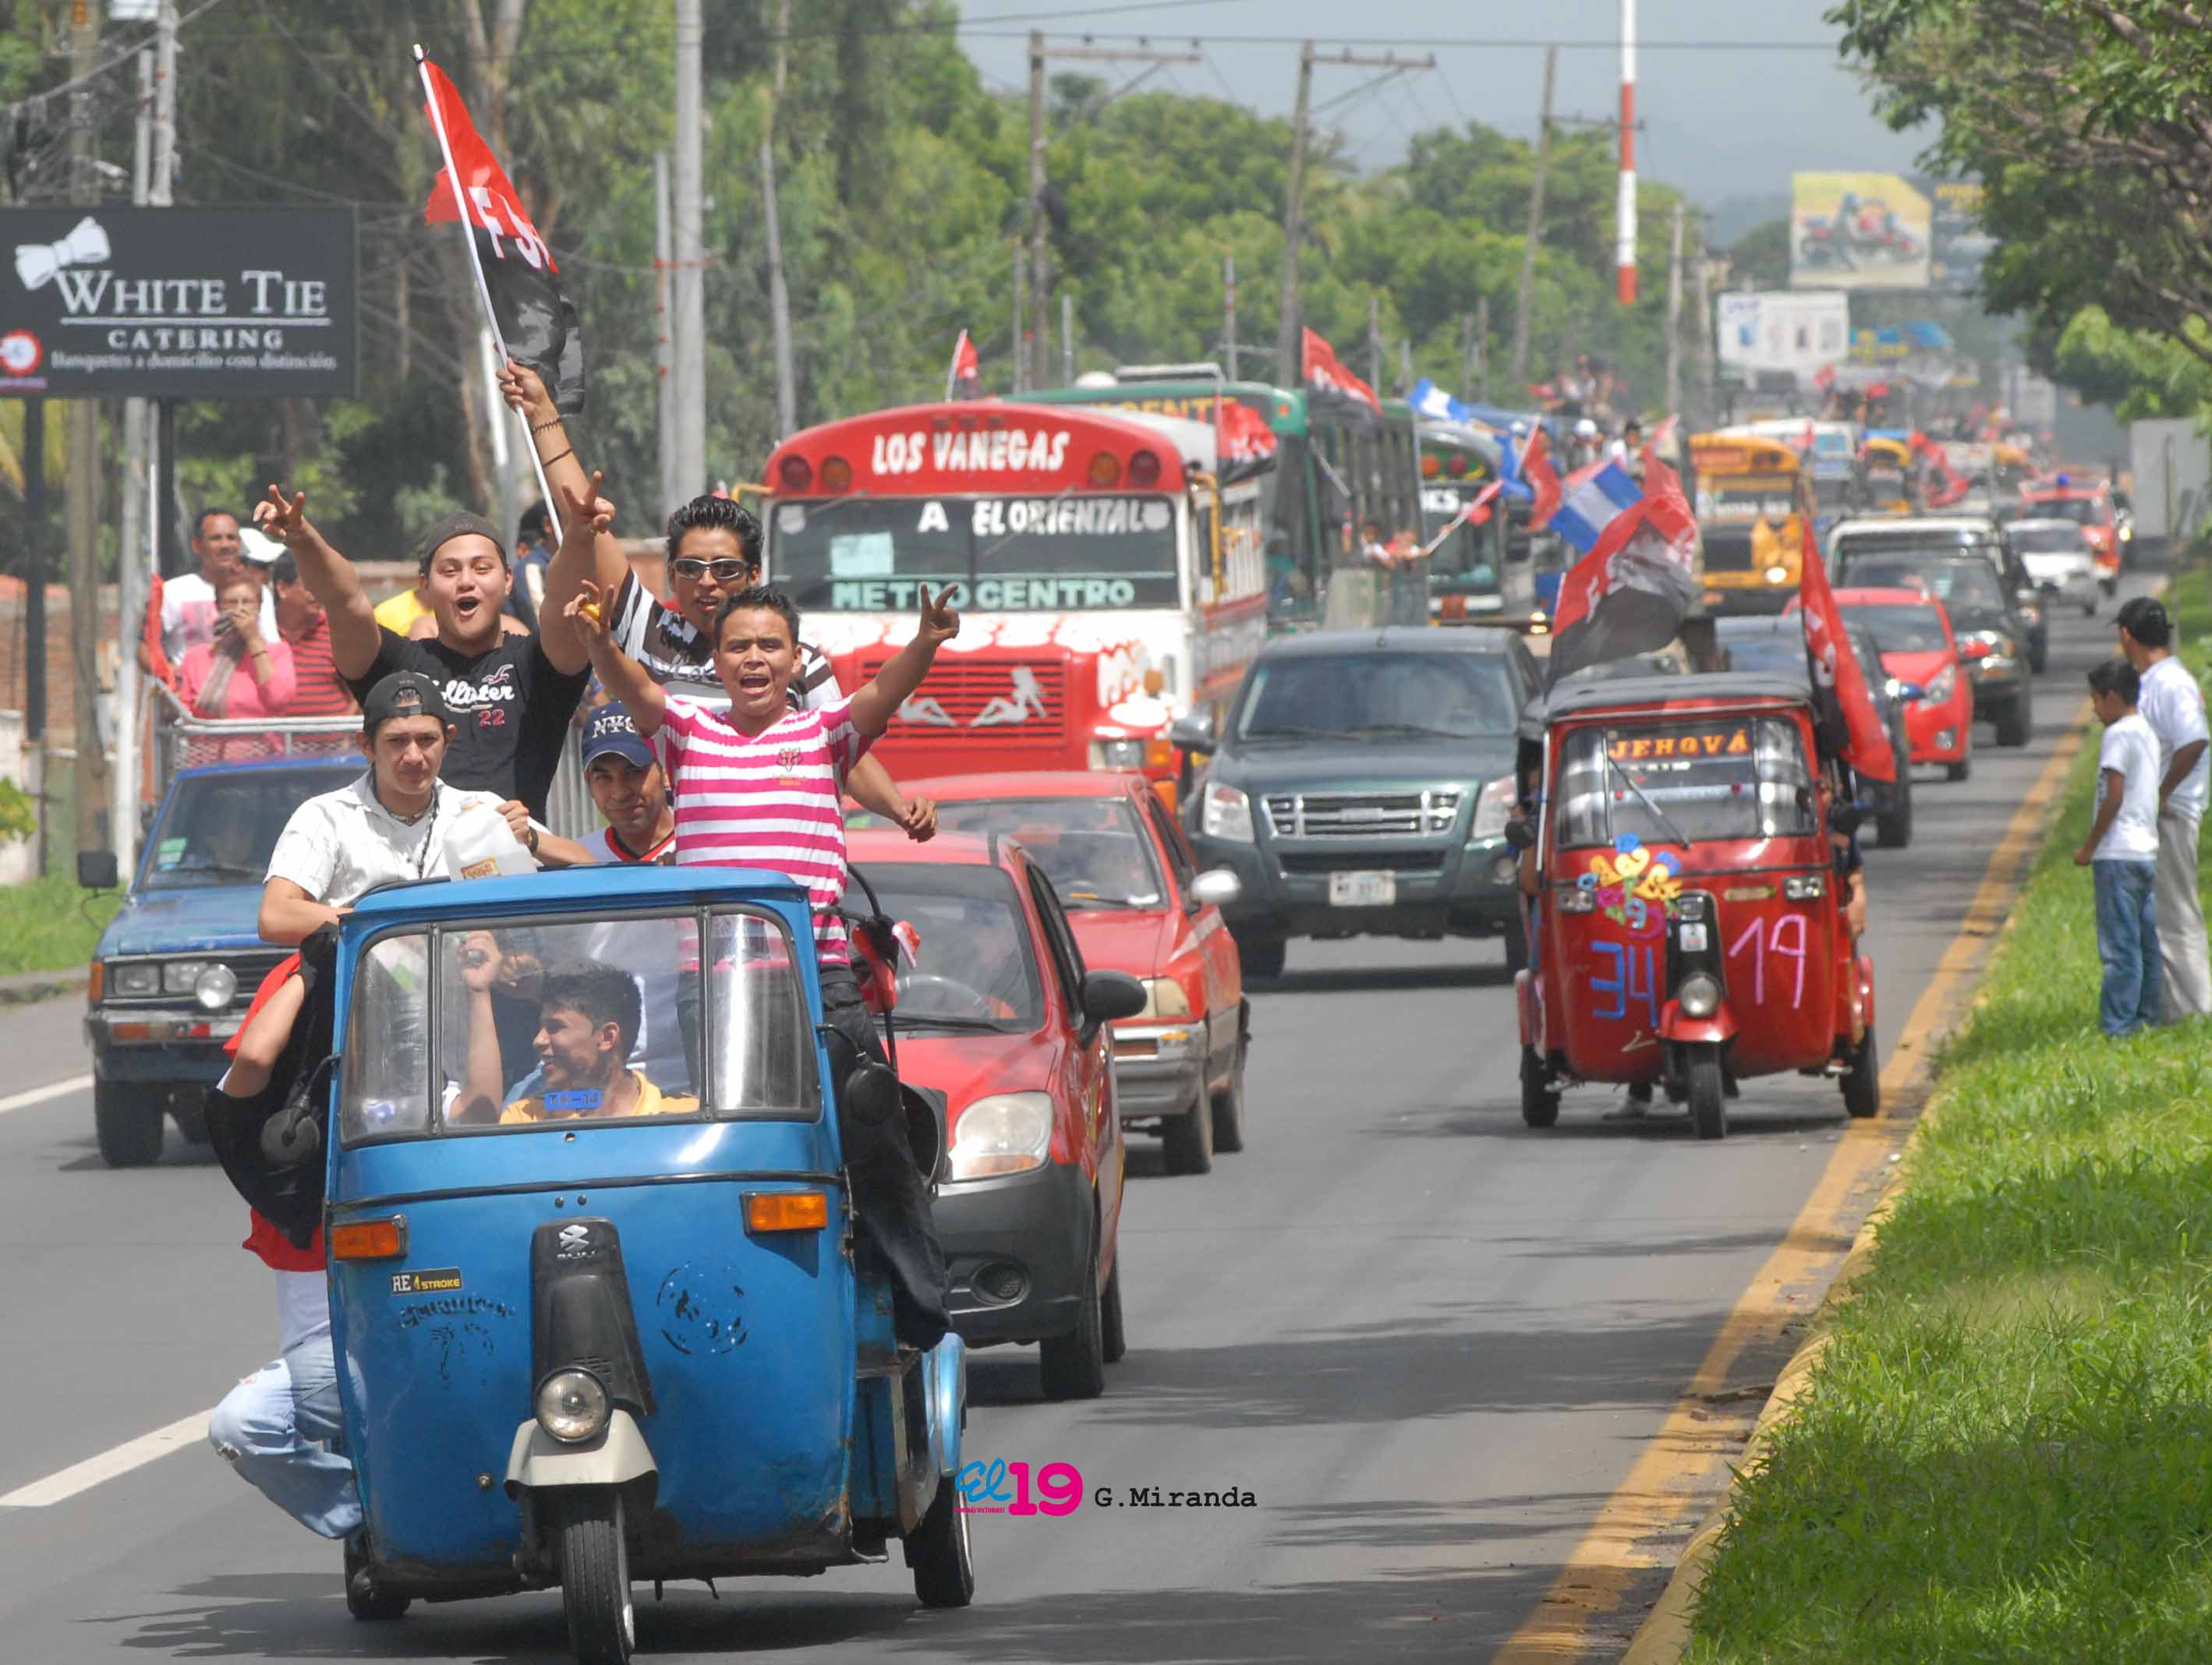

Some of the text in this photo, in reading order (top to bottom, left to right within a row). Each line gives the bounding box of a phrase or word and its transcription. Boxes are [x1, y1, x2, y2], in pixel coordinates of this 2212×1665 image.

[242, 270, 327, 315] TIE
[108, 329, 284, 350] CATERING
[872, 429, 1071, 475] LOS VANEGAS
[917, 498, 1144, 537] A EL ORIENTAL
[975, 578, 1136, 610] CENTRO
[478, 709, 505, 729] 22
[1729, 914, 1807, 1009] 19
[1591, 940, 1659, 1027] 34
[392, 1274, 411, 1292] RE
